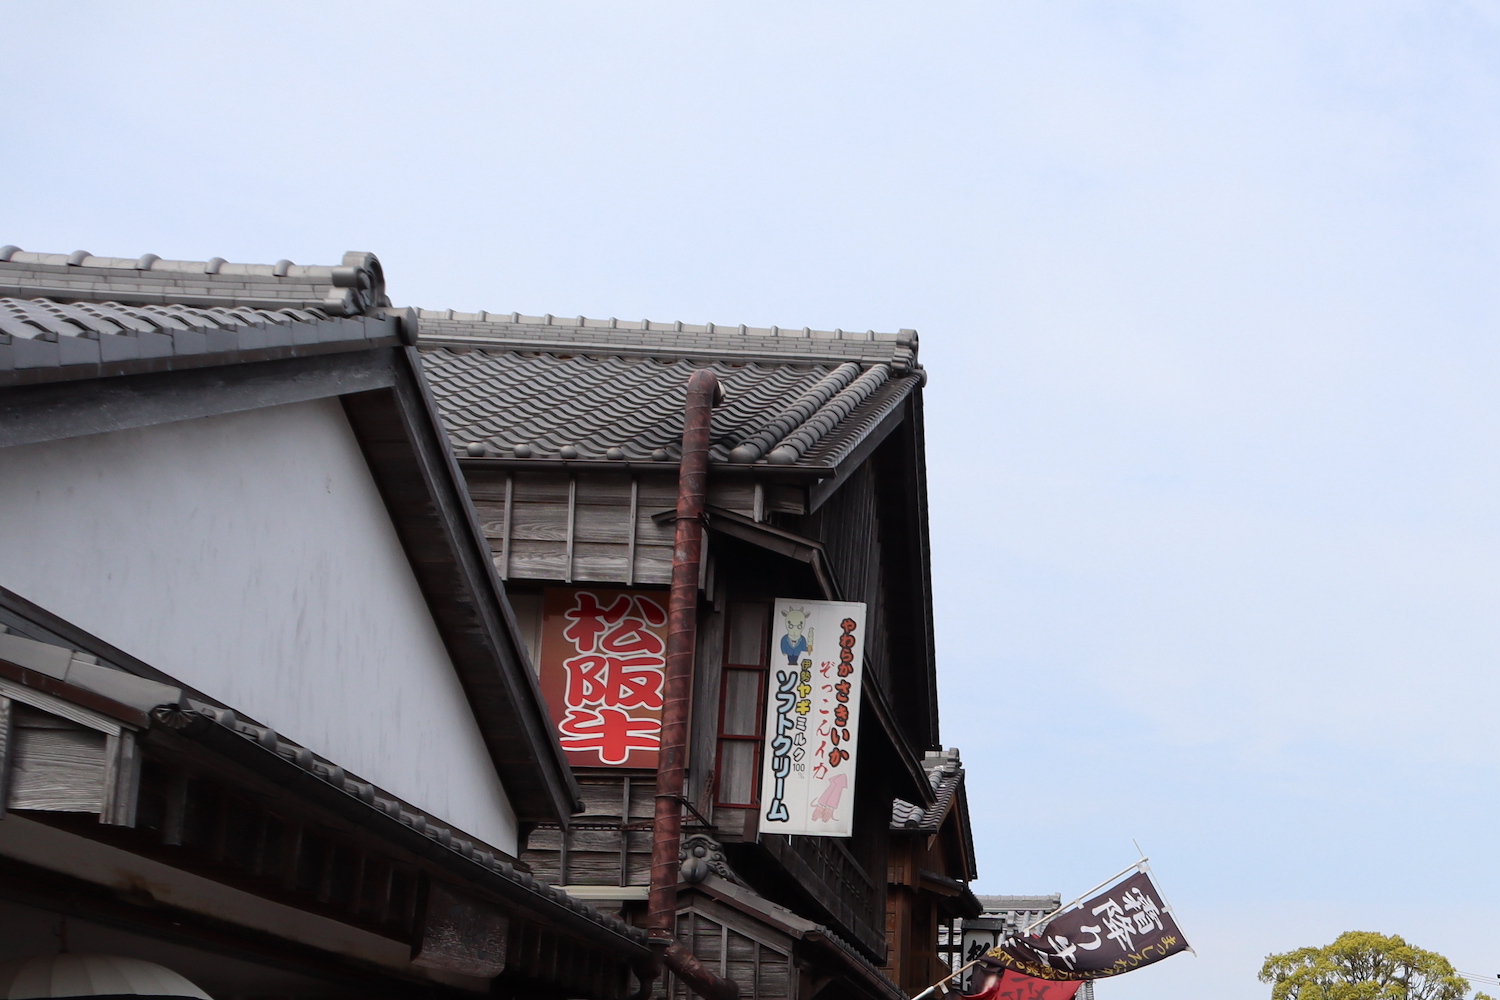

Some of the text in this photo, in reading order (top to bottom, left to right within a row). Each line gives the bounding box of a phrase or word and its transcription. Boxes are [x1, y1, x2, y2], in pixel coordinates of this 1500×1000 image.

[558, 591, 668, 765] 松阪牛
[767, 669, 799, 823] ソフトクリーム
[812, 659, 836, 781] ぞっこんイカ
